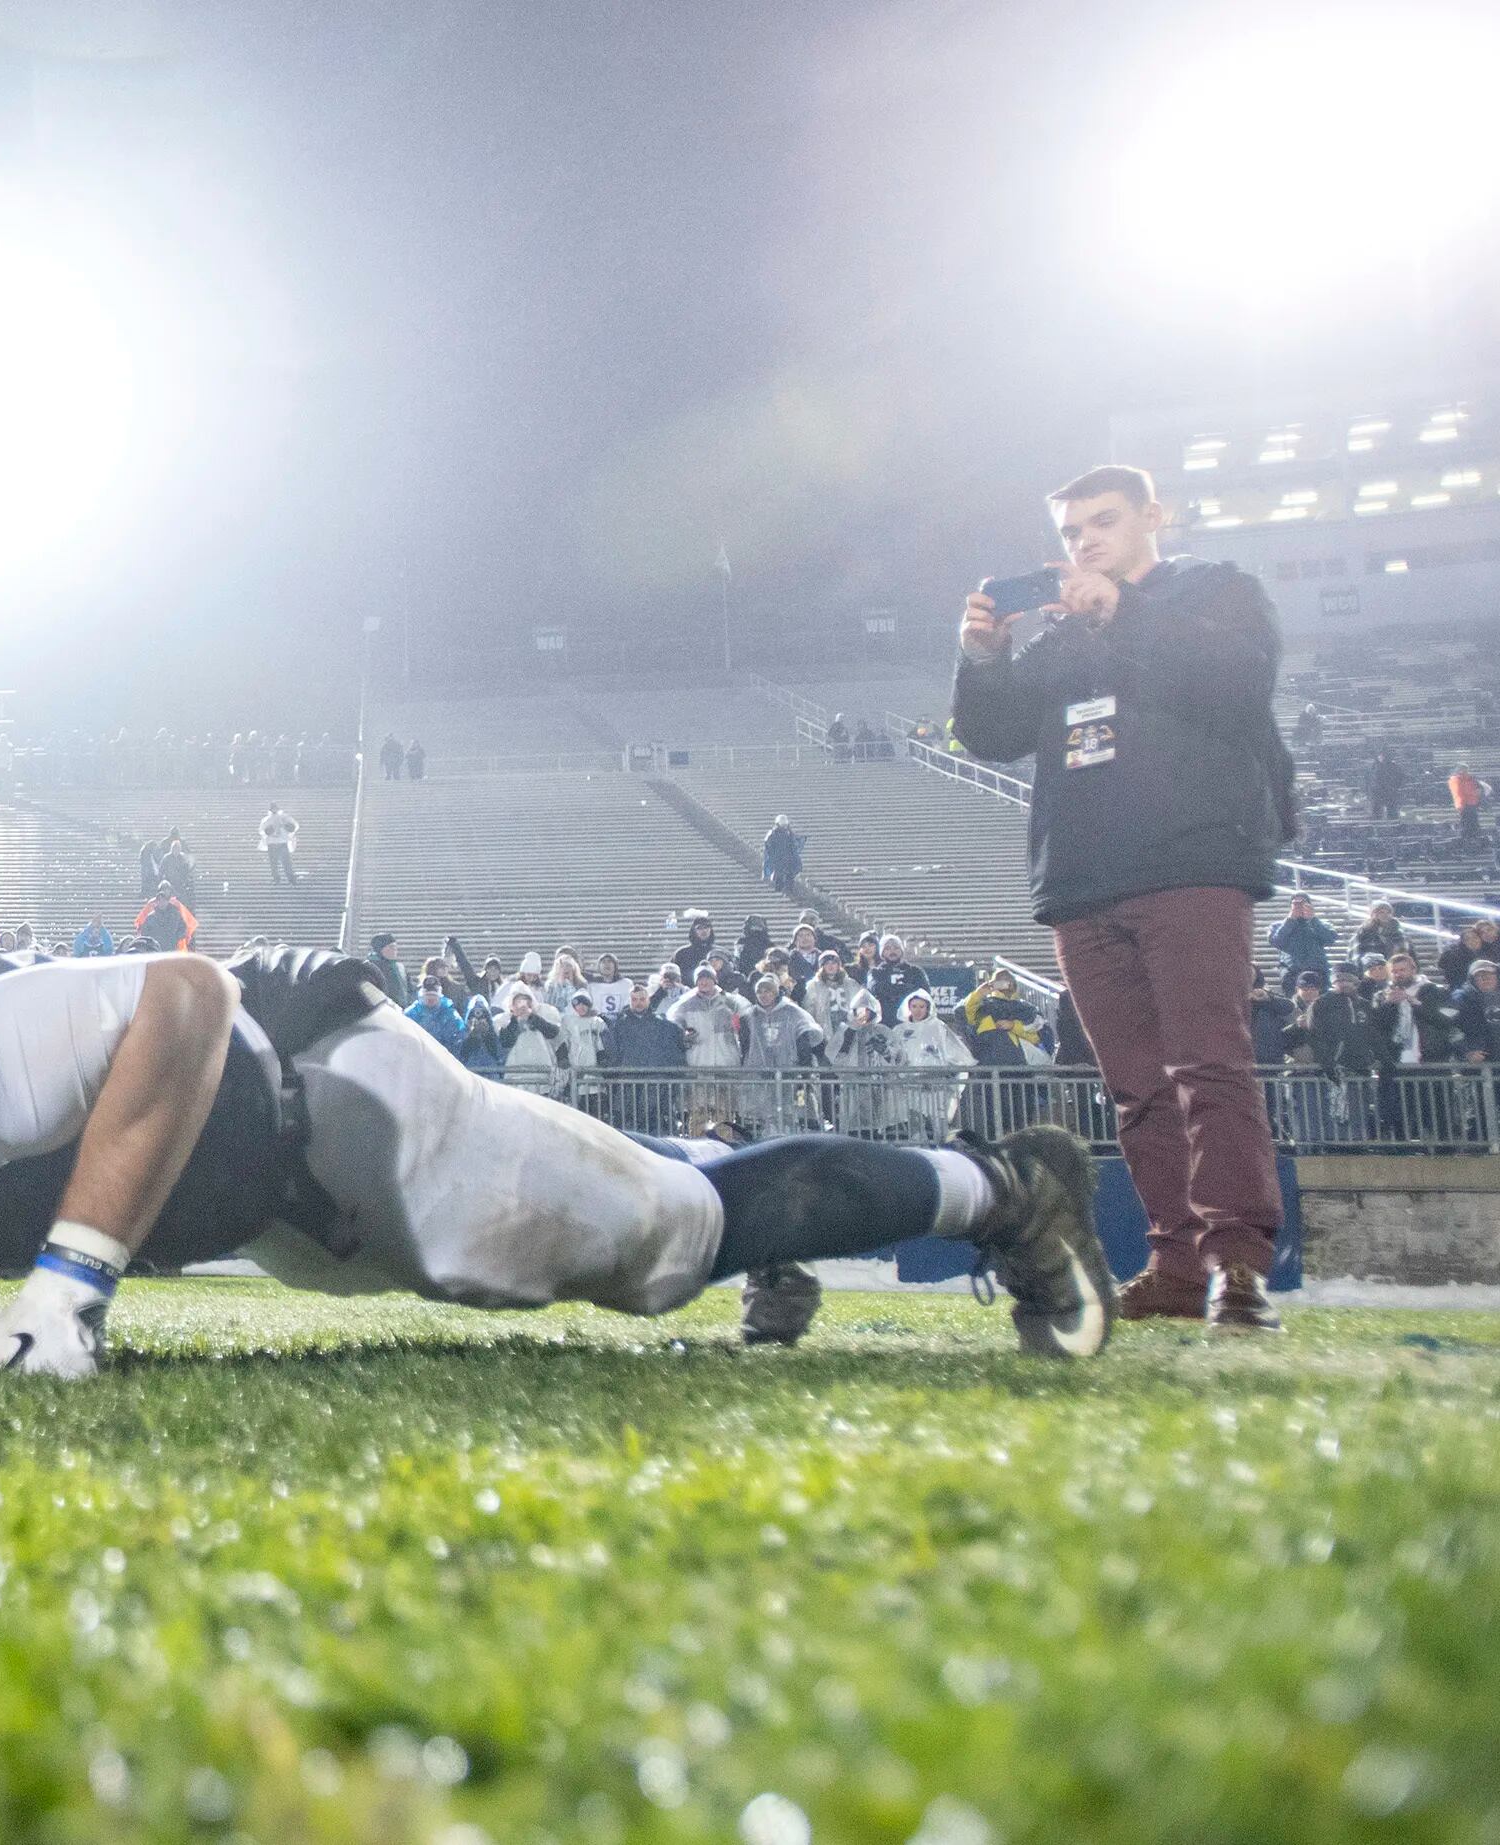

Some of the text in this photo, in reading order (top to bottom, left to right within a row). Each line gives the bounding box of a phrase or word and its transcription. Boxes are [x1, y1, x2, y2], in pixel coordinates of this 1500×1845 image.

[930, 986, 958, 996] KET
[605, 995, 616, 1012] S
[933, 996, 958, 1006] AGE
